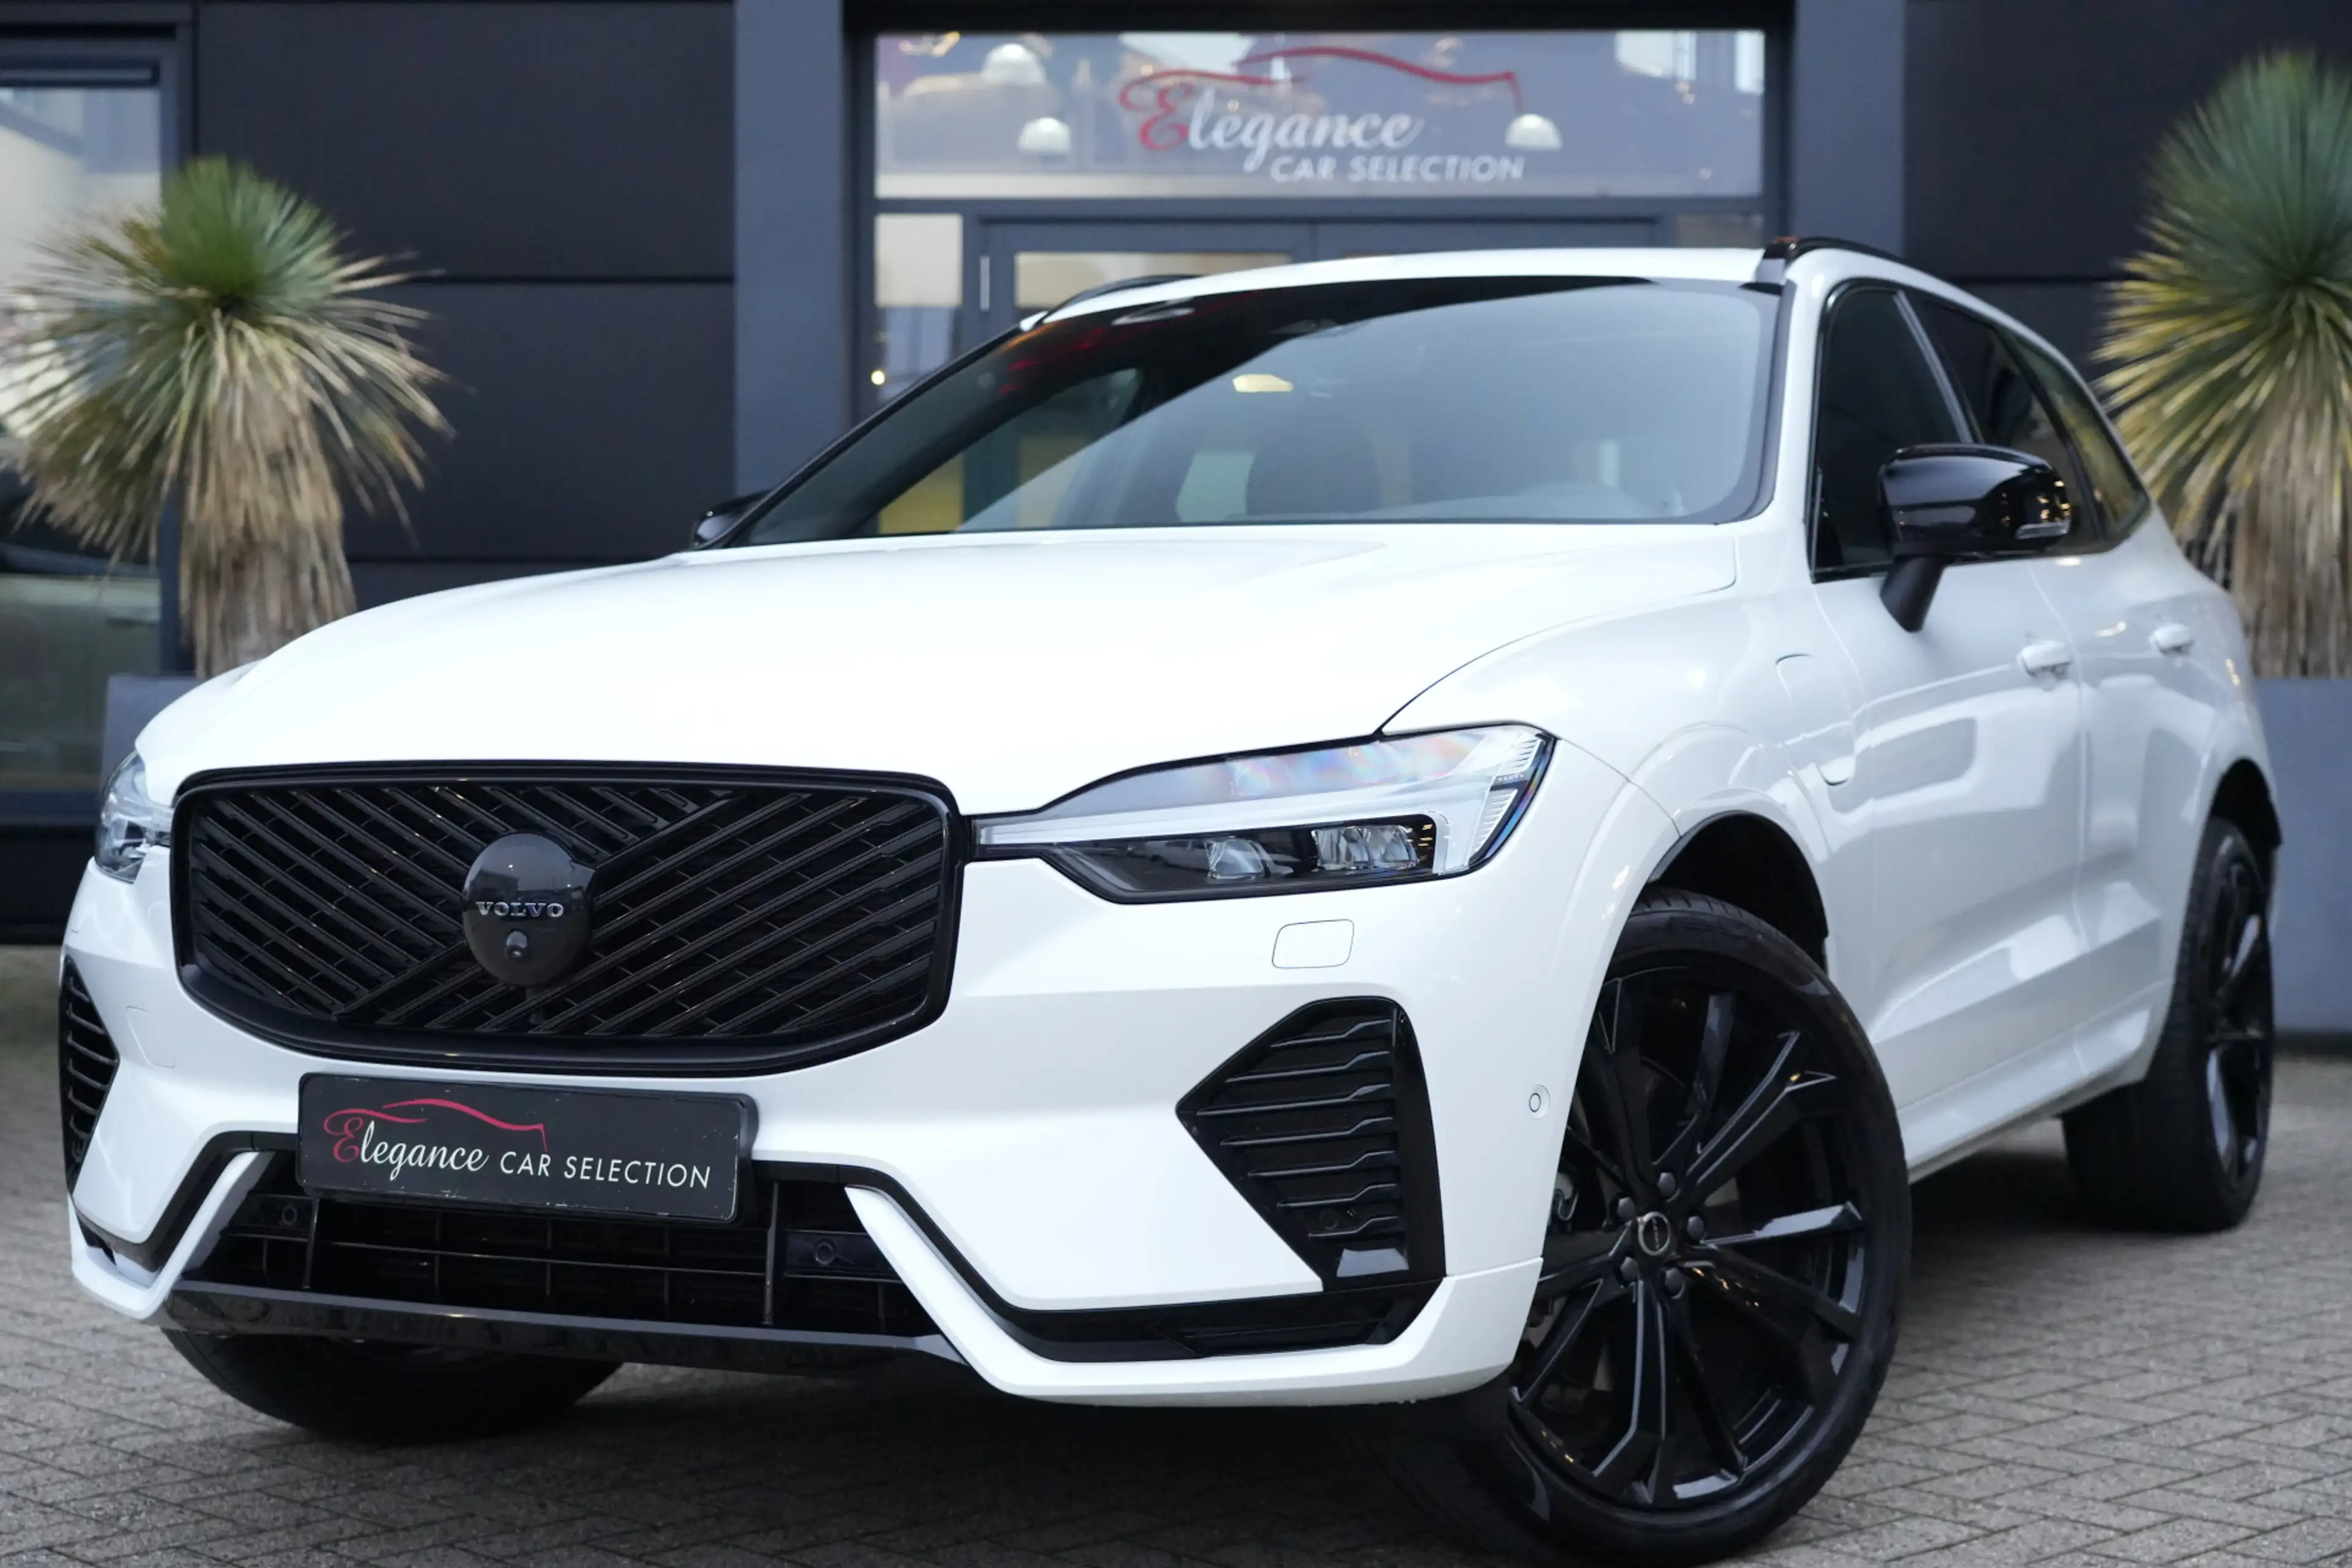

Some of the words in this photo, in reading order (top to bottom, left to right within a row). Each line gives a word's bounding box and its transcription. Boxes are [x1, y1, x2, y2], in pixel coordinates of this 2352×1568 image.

[1120, 72, 1425, 173] Elegance
[1270, 155, 1337, 183] CAR
[1348, 155, 1525, 183] SELECTION
[475, 901, 564, 918] VOLVO
[323, 1109, 489, 1181] Elegance
[500, 1152, 551, 1177] CAR
[564, 1156, 710, 1189] SELECTION
